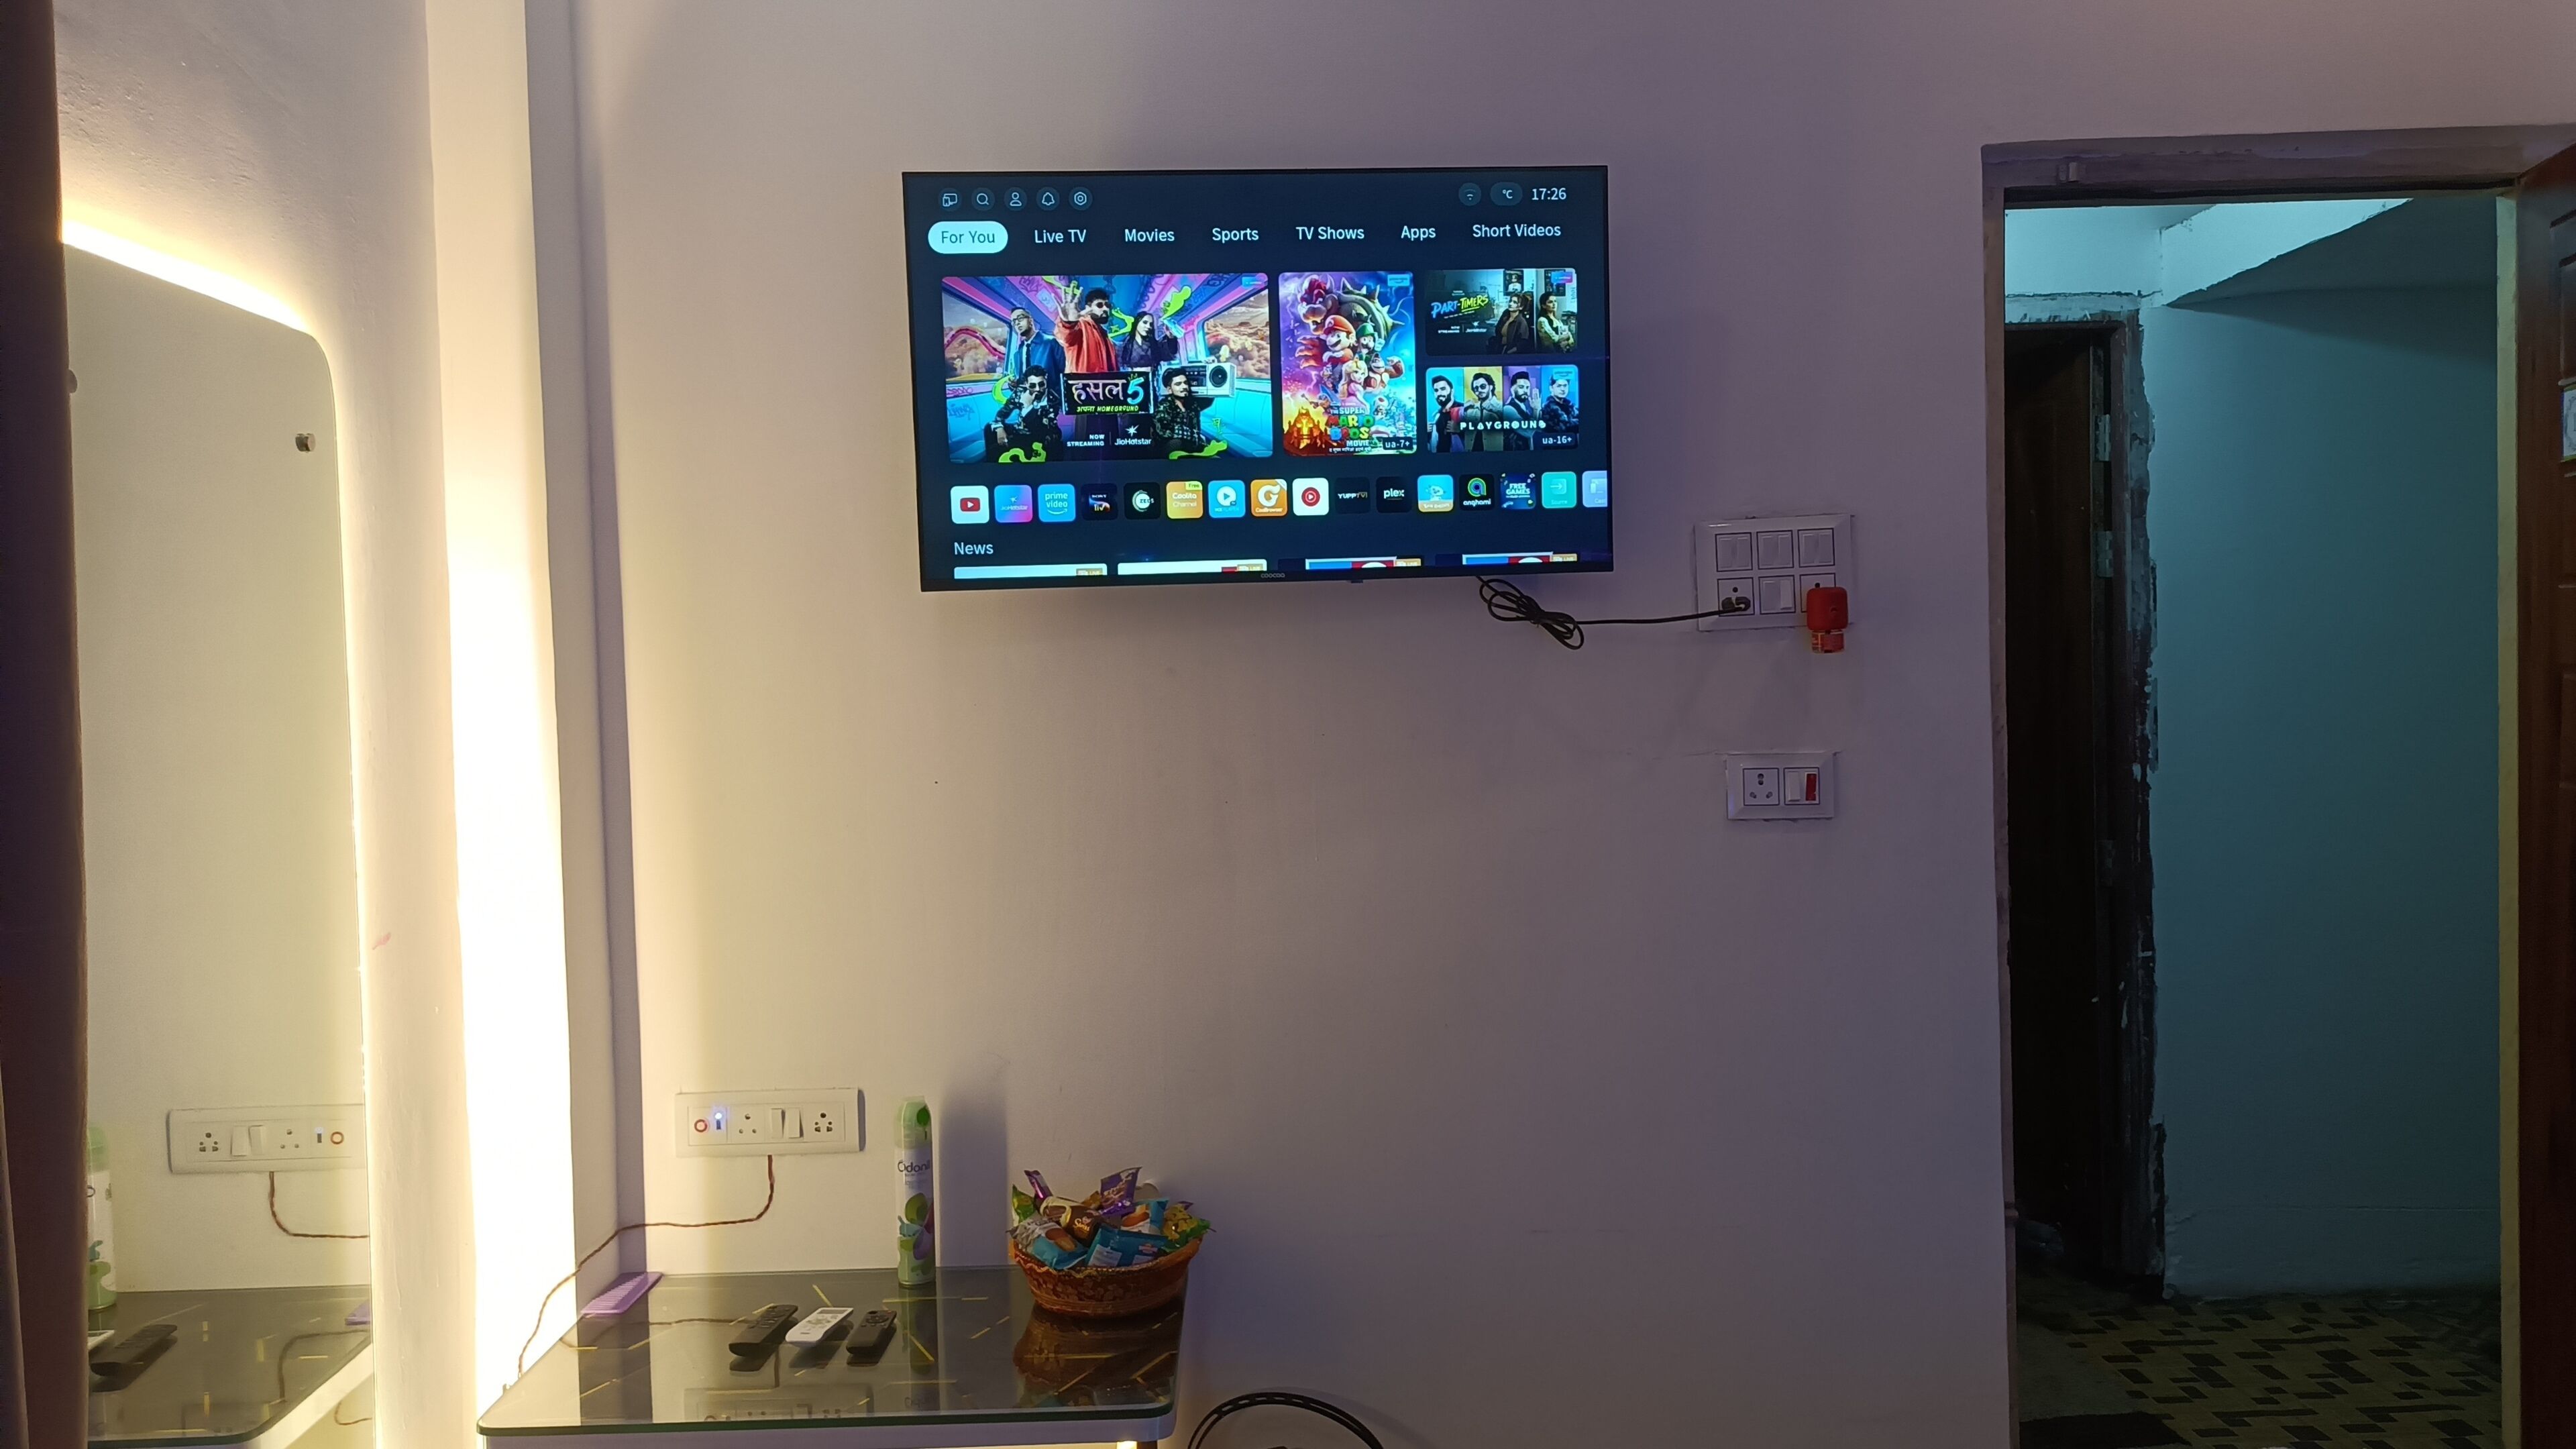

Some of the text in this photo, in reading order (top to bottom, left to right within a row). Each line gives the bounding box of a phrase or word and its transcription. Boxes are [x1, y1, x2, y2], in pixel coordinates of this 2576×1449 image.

[1532, 188, 1566, 200] 17:26
[1124, 229, 1175, 242] Movies
[1212, 227, 1259, 244] Sports
[1296, 226, 1365, 240] TV Shows
[1401, 225, 1436, 241] Apps
[1472, 223, 1562, 237] Short Videos
[941, 230, 996, 244] For You
[1034, 229, 1087, 244] Live TV
[1328, 415, 1375, 427] MARIO
[1460, 420, 1546, 430] PLAYGROUND
[1542, 436, 1572, 445] ua-16+
[1044, 492, 1068, 501] prime
[1383, 488, 1405, 498] plex
[1046, 500, 1068, 508] video
[1463, 498, 1491, 507] anghami
[954, 541, 994, 555] News
